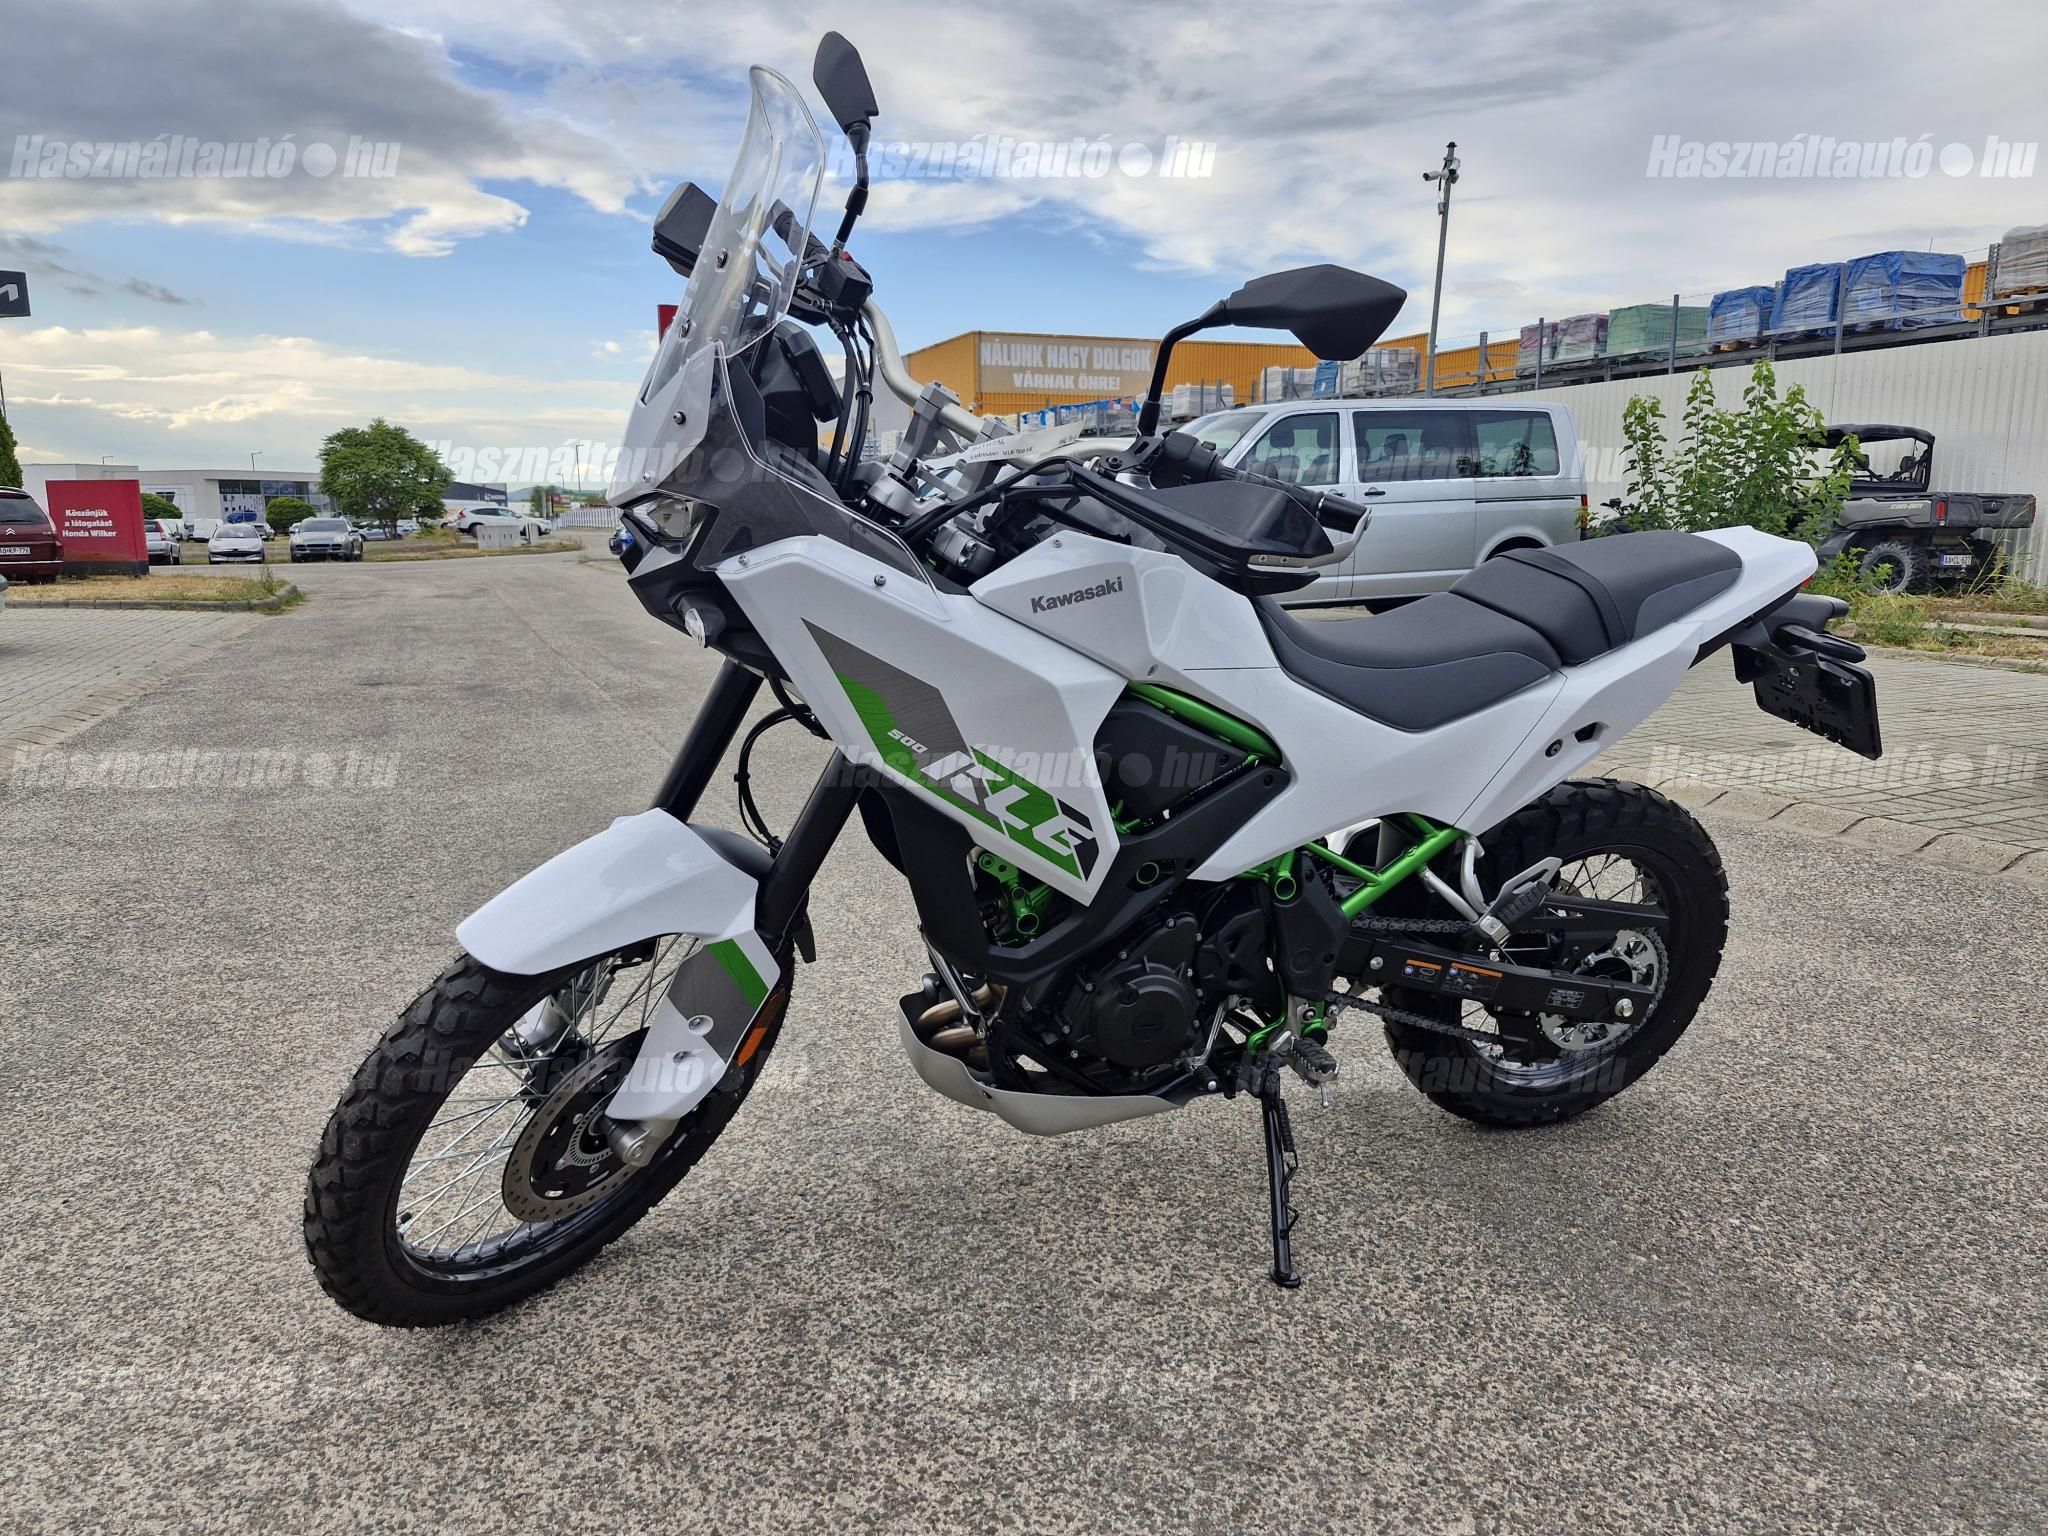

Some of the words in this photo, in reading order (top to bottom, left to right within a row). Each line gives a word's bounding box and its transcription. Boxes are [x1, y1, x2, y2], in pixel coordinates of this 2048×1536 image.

[981, 338, 1043, 367] NÁLUNK
[1047, 344, 1089, 369] NAGY
[1093, 347, 1152, 372] DOLGOK
[1013, 371, 1074, 389] VÁRNAK
[1078, 372, 1121, 391] ÖNRE!
[65, 509, 108, 518] Köszönjük
[71, 519, 113, 528] látogatást
[62, 529, 89, 537] Honda
[90, 529, 117, 538] Wilker
[1030, 576, 1123, 614] Kawasaki
[887, 729, 928, 754] 500
